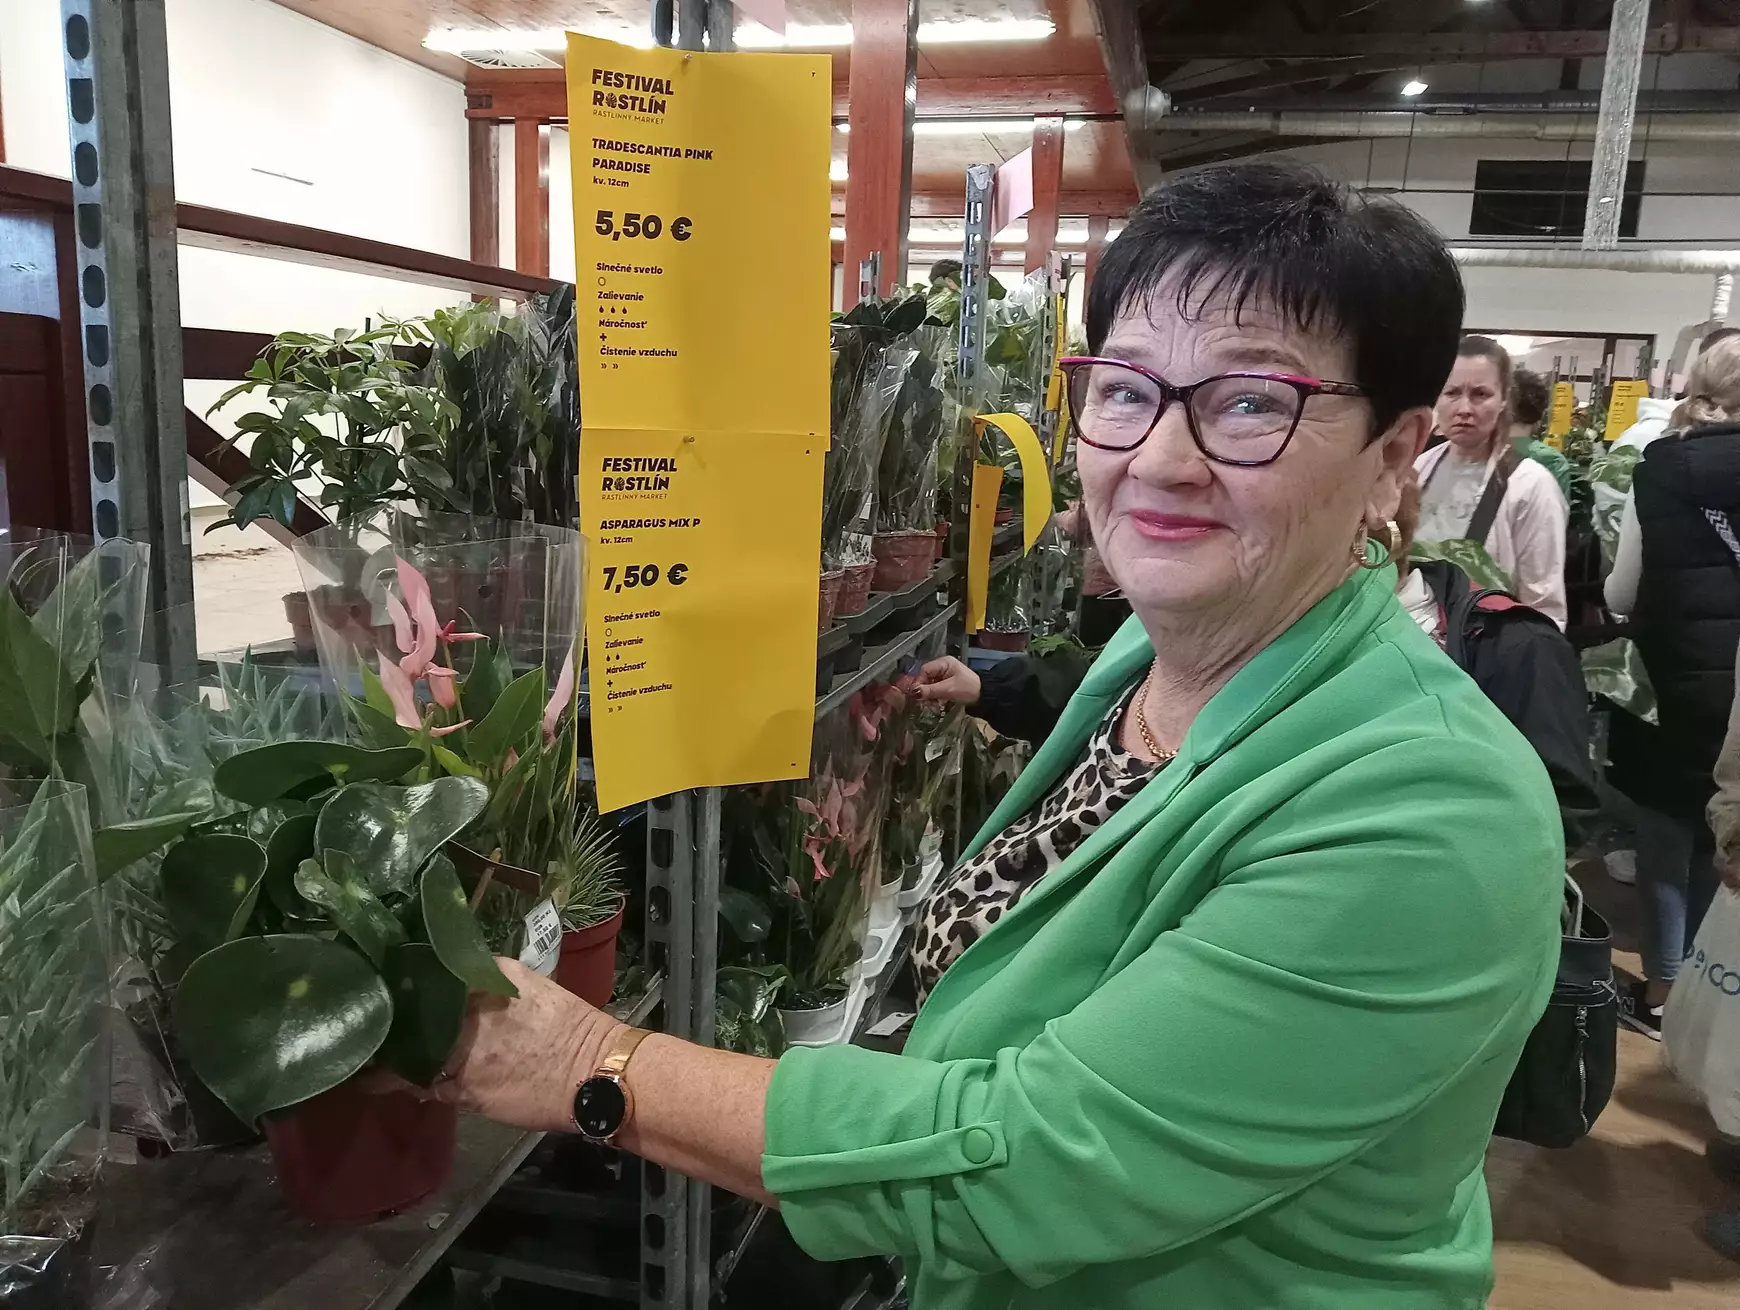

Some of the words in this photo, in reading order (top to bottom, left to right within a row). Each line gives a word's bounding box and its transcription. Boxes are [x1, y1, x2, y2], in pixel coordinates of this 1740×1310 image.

[591, 68, 674, 96] FESTIVAL
[633, 115, 664, 125] MARKET
[592, 138, 682, 158] TRADESCANTIA
[684, 148, 714, 161] PINK
[592, 157, 651, 174] PARADISE
[592, 175, 606, 185] kv.
[607, 177, 630, 188] 12cm
[594, 209, 663, 242] 5,50
[669, 216, 693, 242] €
[596, 262, 632, 273] Slnečné
[633, 265, 663, 275] svetlo
[597, 290, 645, 302] Zalievanie
[598, 318, 648, 329] Náročnosť
[599, 344, 637, 356] Čistenie
[638, 347, 678, 357] vzduchu
[601, 457, 678, 473] FESTIVAL
[599, 518, 667, 530] ASPARAGUS
[668, 518, 691, 528] MIX
[692, 518, 701, 528] P
[600, 536, 613, 545] kv.
[613, 536, 633, 544] 12cm
[602, 563, 660, 594] 7,50
[666, 563, 689, 586] €
[603, 611, 634, 624] Slnečné
[634, 609, 661, 620] svetlo
[604, 636, 644, 649] Zalievanie
[605, 661, 647, 675] Náročnosť
[607, 688, 638, 701] Čistenie
[638, 682, 673, 695] vzduchu
